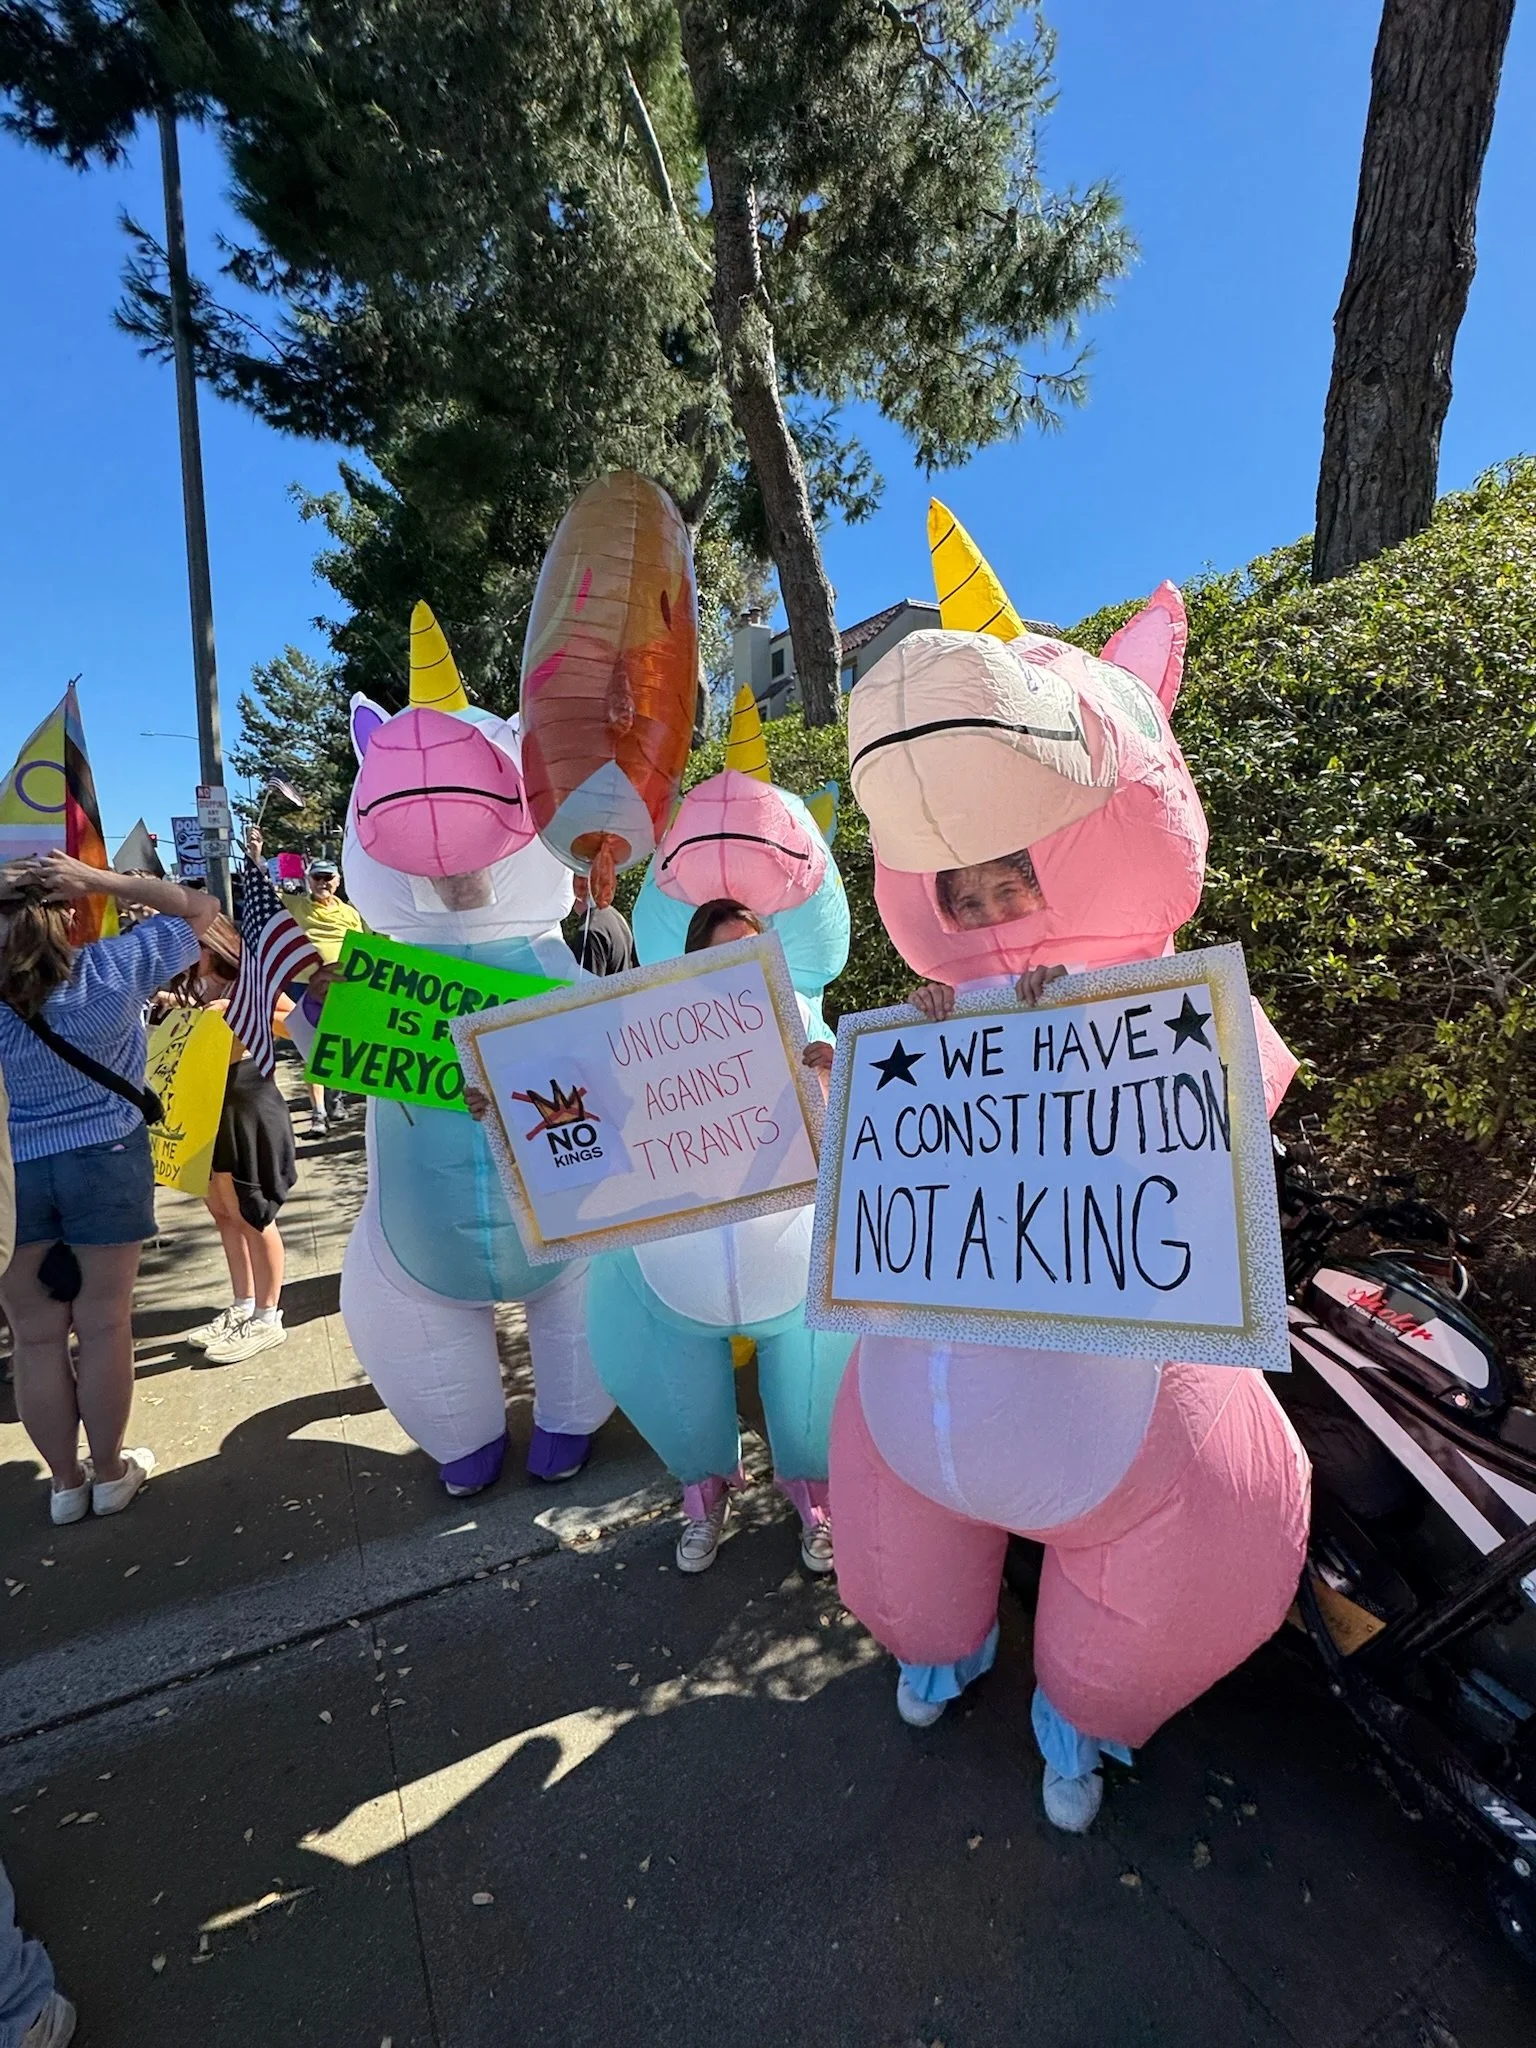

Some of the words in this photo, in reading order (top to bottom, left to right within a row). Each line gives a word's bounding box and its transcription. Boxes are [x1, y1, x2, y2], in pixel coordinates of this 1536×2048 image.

[343, 947, 519, 1016] DEMOCRA
[387, 1007, 422, 1036] IS
[432, 1019, 456, 1046] F
[606, 989, 764, 1067] UNICORNS
[939, 1025, 1005, 1079] WE
[1033, 1004, 1158, 1073] HAVE
[646, 1050, 753, 1120] AGAINST
[852, 1115, 883, 1161] A
[895, 1057, 1232, 1159] CONSTITUTION
[162, 1140, 177, 1159] ME
[546, 1123, 597, 1155] NO
[554, 1146, 603, 1168] KINGS
[632, 1106, 780, 1180] TYRANTS
[855, 1184, 950, 1281] NOT
[957, 1186, 995, 1280] A
[1016, 1174, 1191, 1292] KING
